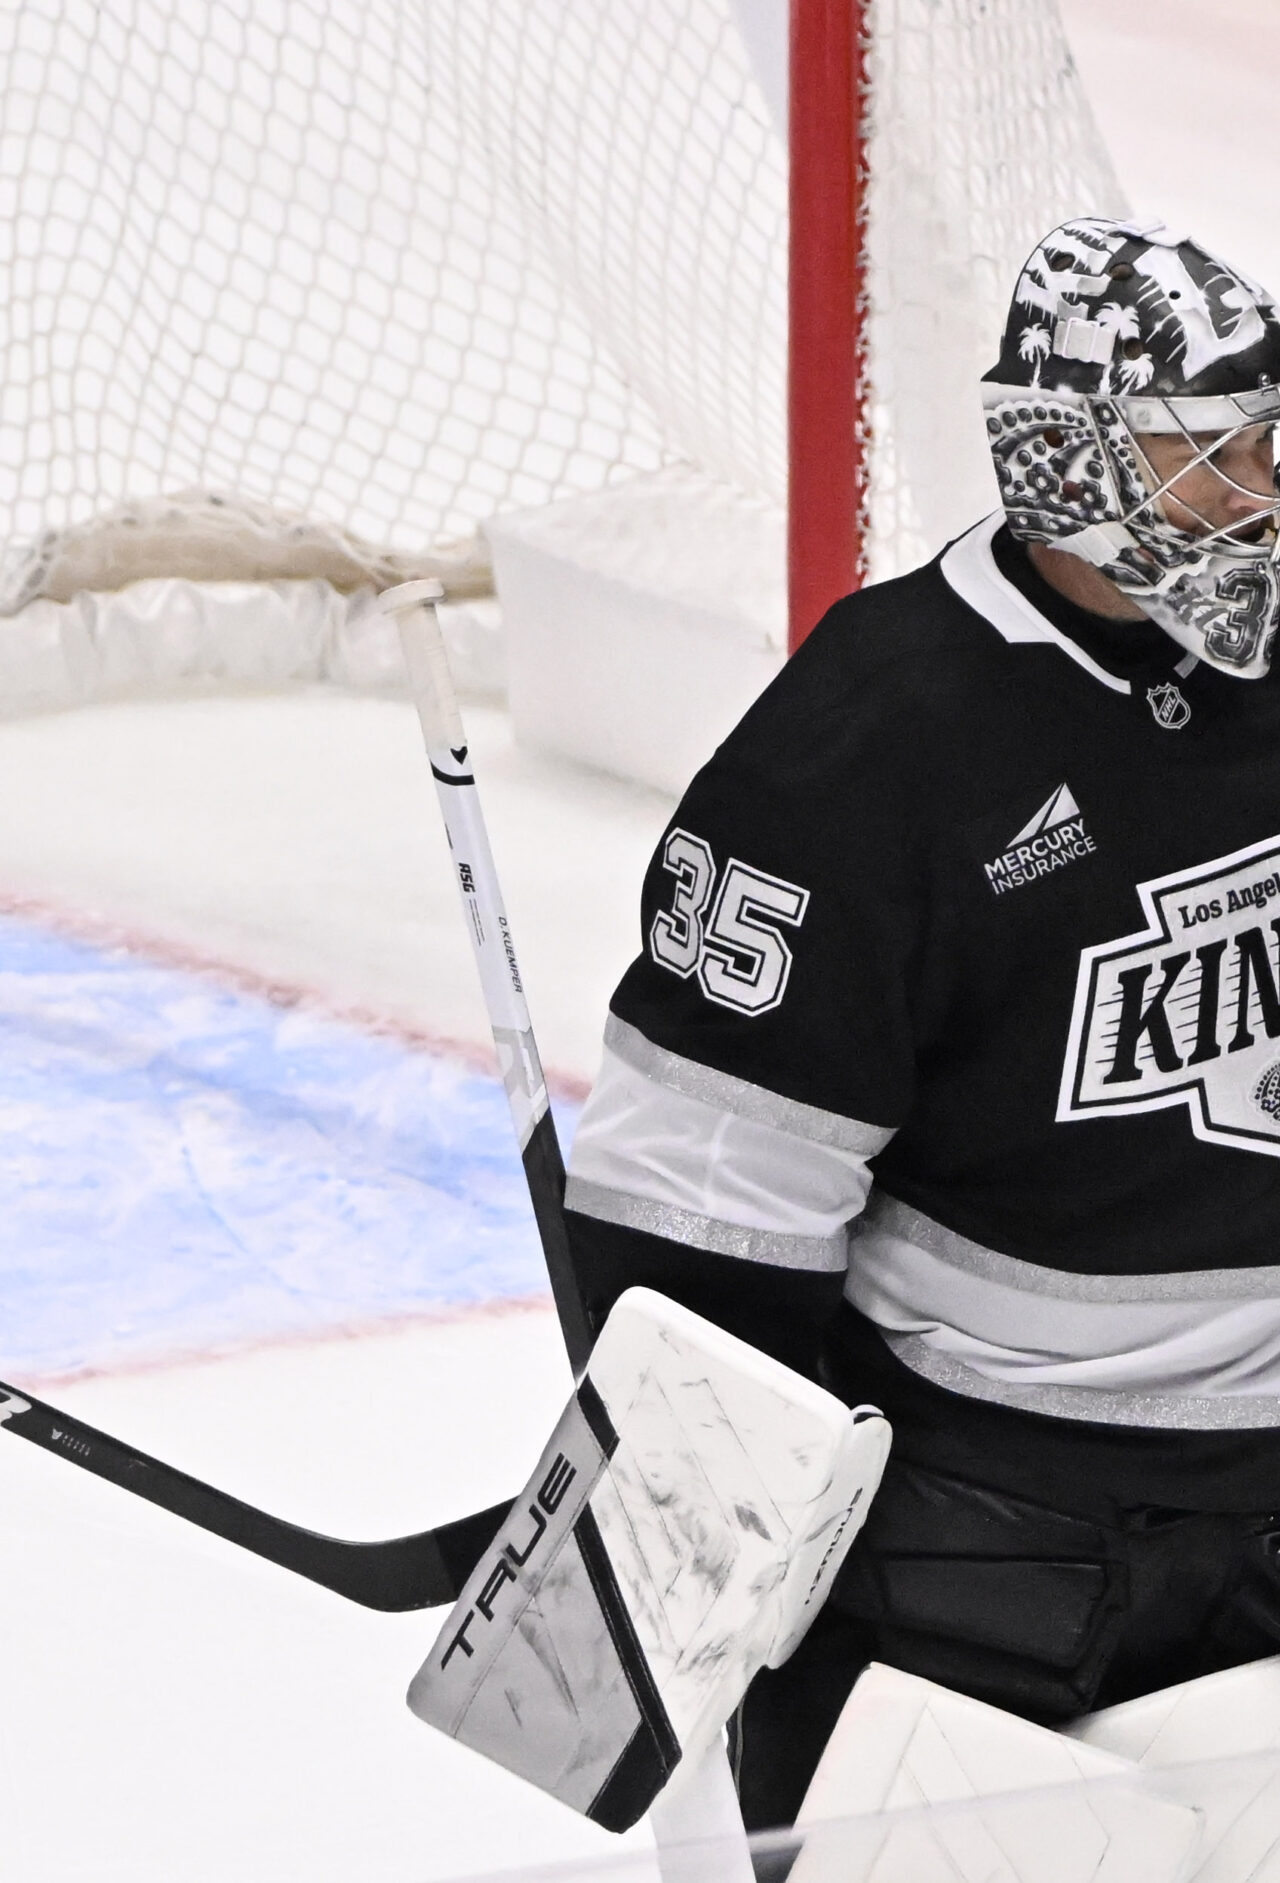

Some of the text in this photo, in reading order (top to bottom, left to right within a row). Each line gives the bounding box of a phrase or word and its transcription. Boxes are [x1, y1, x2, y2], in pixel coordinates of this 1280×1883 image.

[1160, 694, 1178, 721] NHL
[458, 862, 476, 893] ASG
[984, 818, 1085, 880] MERCURY
[992, 836, 1097, 895] INSURANCE
[650, 827, 810, 1017] 35
[1178, 900, 1223, 928] Los
[502, 930, 523, 993] KUEMPER
[441, 1452, 577, 1670] TRUE
